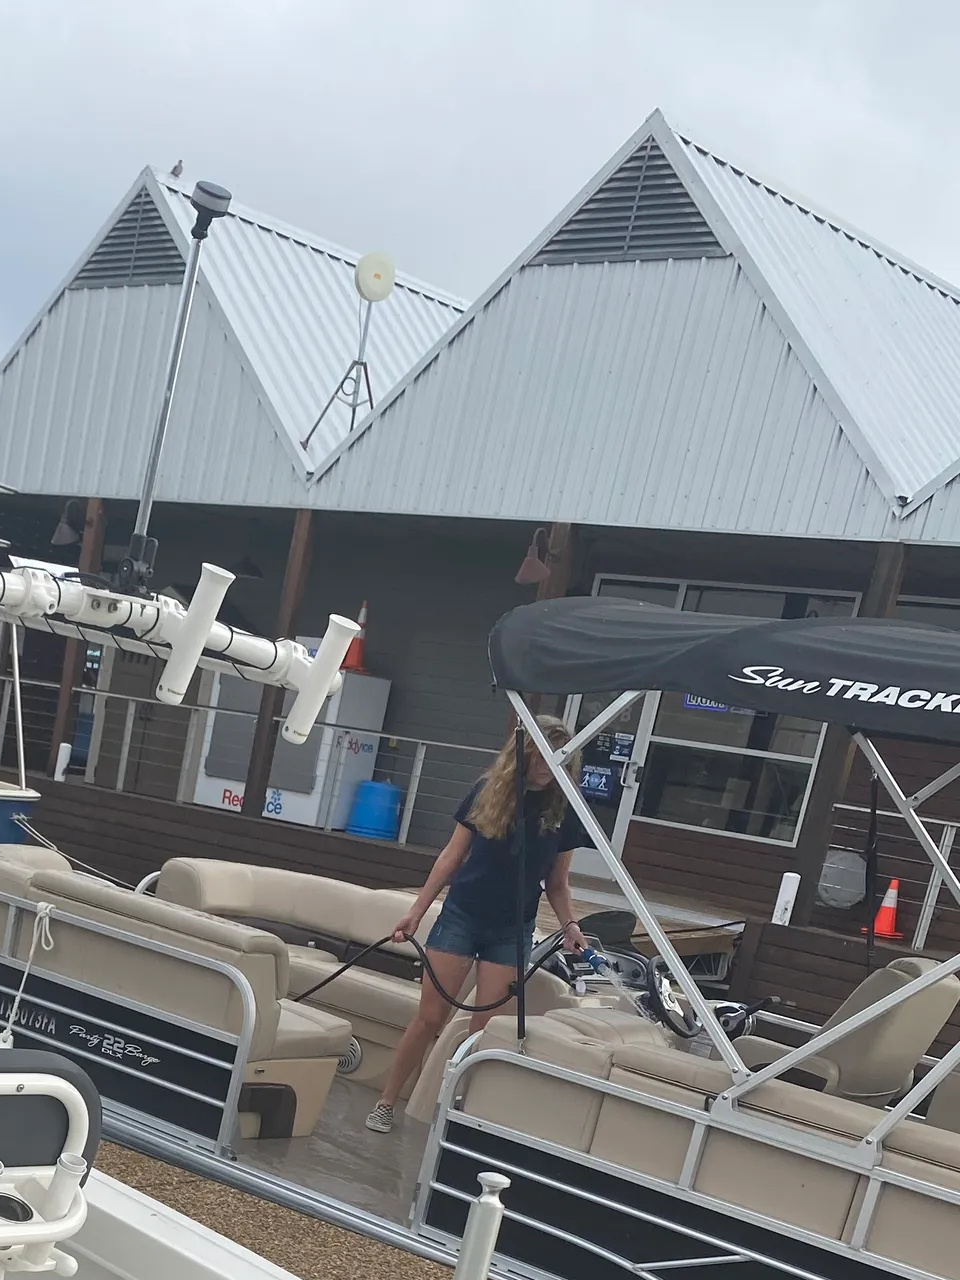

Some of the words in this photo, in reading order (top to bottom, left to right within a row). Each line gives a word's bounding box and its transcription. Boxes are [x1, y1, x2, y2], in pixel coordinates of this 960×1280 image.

[728, 665, 822, 694] Sun
[825, 677, 960, 713] TRACK
[69, 1025, 103, 1047] Party
[102, 1033, 126, 1053] 22
[124, 1044, 161, 1066] Barge
[101, 1047, 123, 1059] DLX
